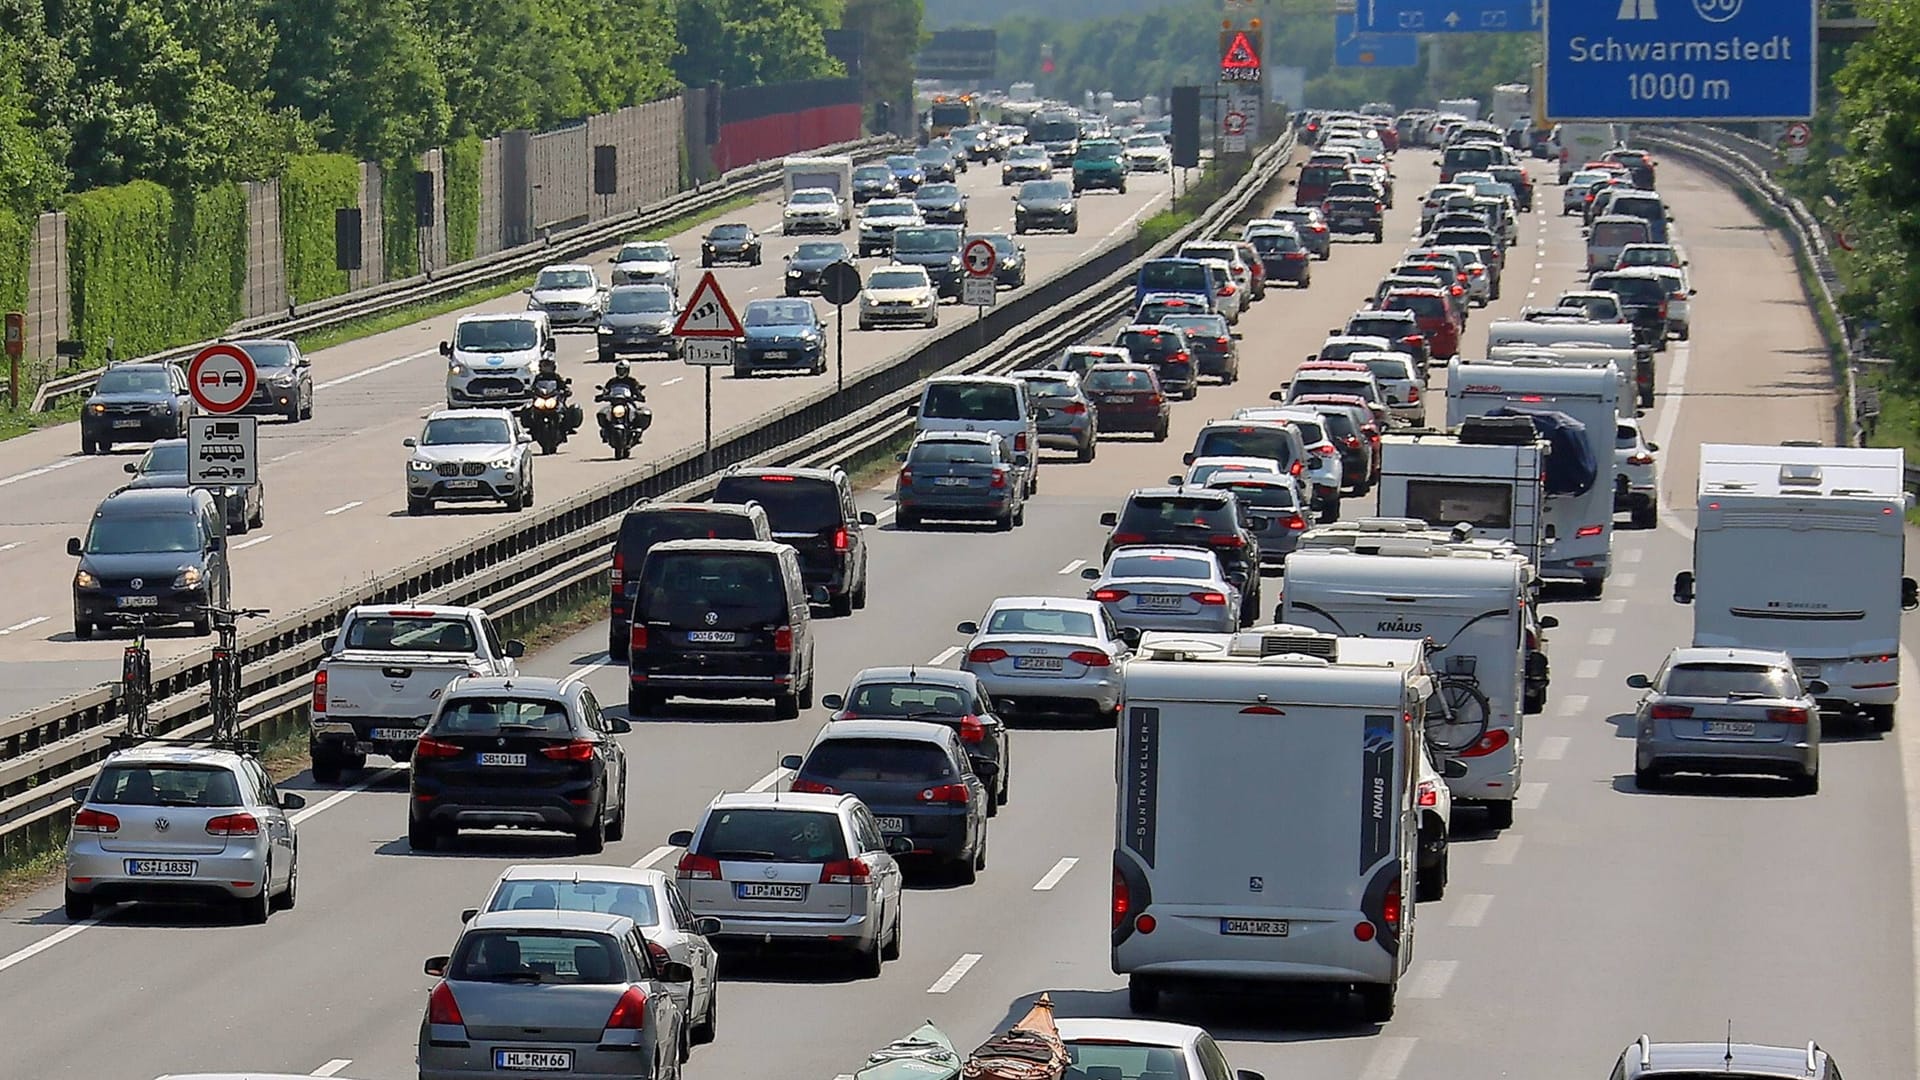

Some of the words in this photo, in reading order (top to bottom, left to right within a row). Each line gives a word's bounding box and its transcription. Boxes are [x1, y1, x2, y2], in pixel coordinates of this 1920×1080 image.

[1569, 36, 1791, 62] Schwarmstedt
[1628, 73, 1695, 99] 1000
[1702, 78, 1730, 99] m
[1377, 621, 1423, 632] KNAUS
[483, 754, 494, 764] SB
[1136, 725, 1149, 836] SUNTRAVELLER
[1373, 777, 1385, 819] KNAUS
[136, 862, 150, 872] KS
[165, 862, 190, 873] 1833
[745, 885, 763, 896] LIP
[770, 886, 783, 897] AW
[784, 887, 801, 897] 575
[1256, 922, 1271, 933] WR
[1272, 923, 1286, 933] 33
[508, 1053, 524, 1066] HL
[532, 1054, 548, 1066] RM
[550, 1055, 565, 1066] 66
